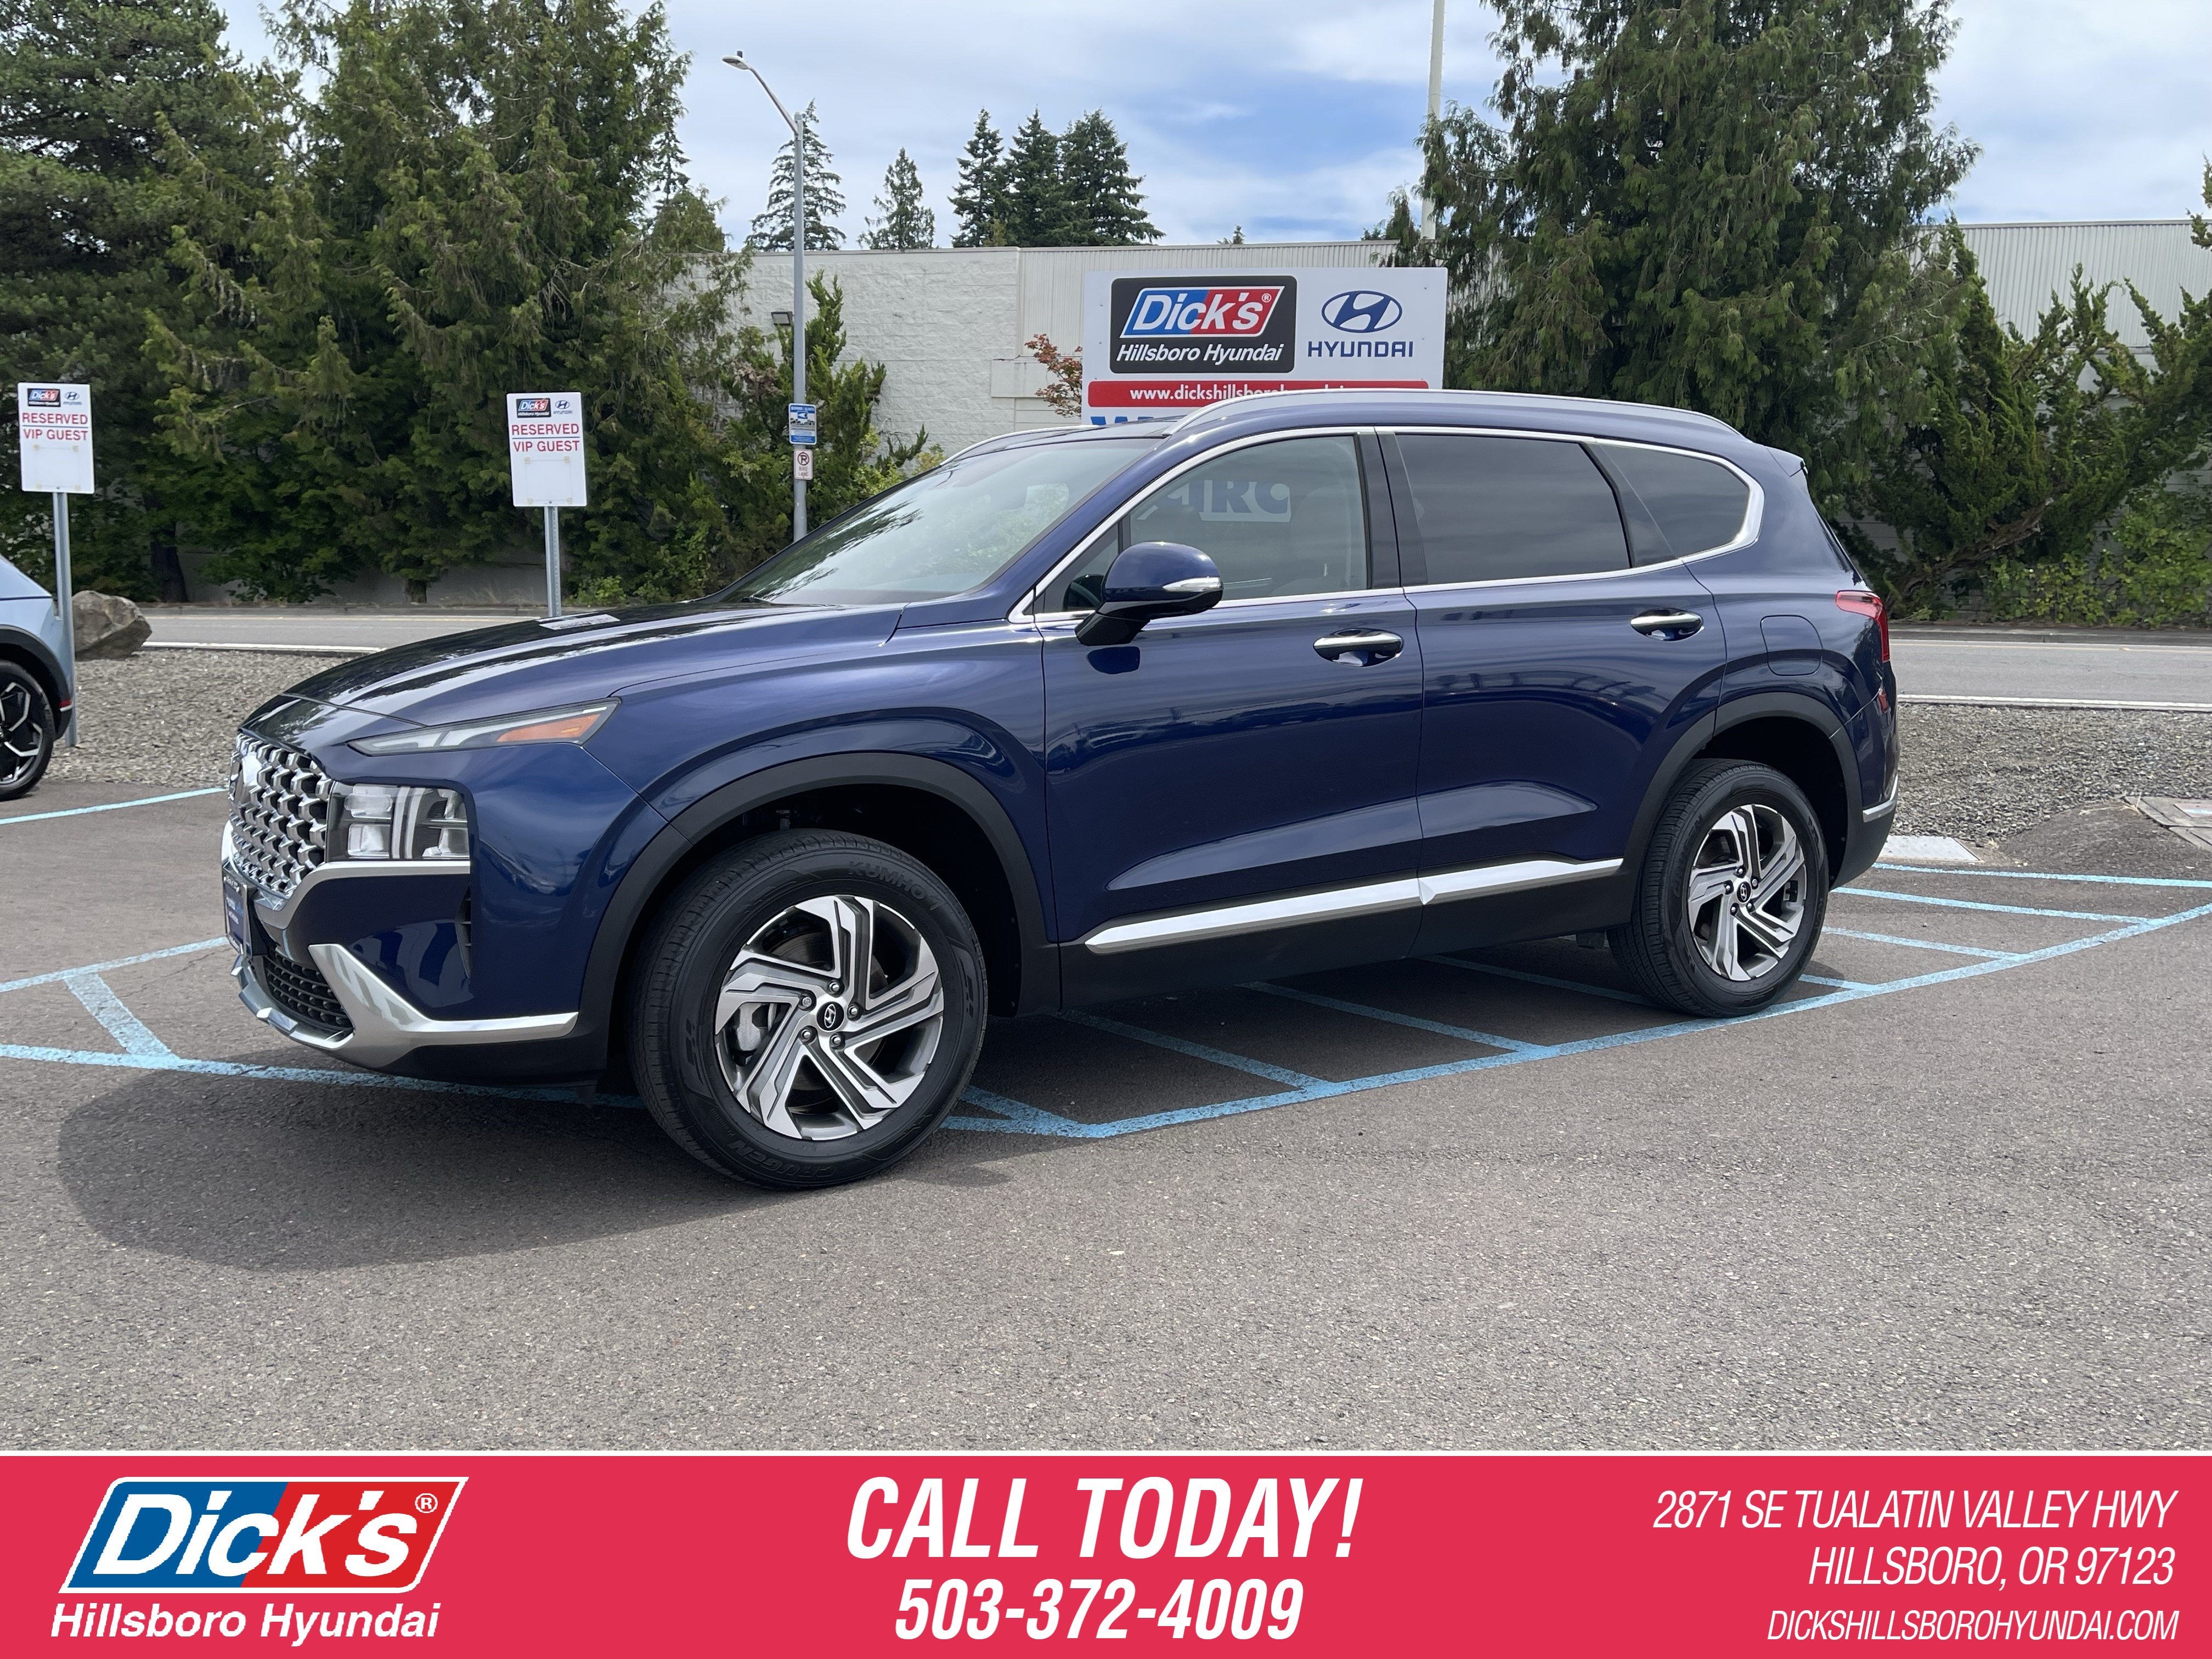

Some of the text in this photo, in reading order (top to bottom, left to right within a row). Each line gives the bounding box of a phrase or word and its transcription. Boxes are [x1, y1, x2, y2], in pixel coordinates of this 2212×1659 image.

[1131, 291, 1263, 331] Dick's
[1116, 343, 1284, 365] Hillsboro Hyundai
[1307, 341, 1413, 357] HYUNDAI
[22, 413, 87, 424] RESERVED
[24, 429, 88, 441] VIP GUEST
[512, 424, 579, 435] RESERVED
[514, 441, 580, 452] VIP GUEST
[848, 861, 926, 900] KUMHO
